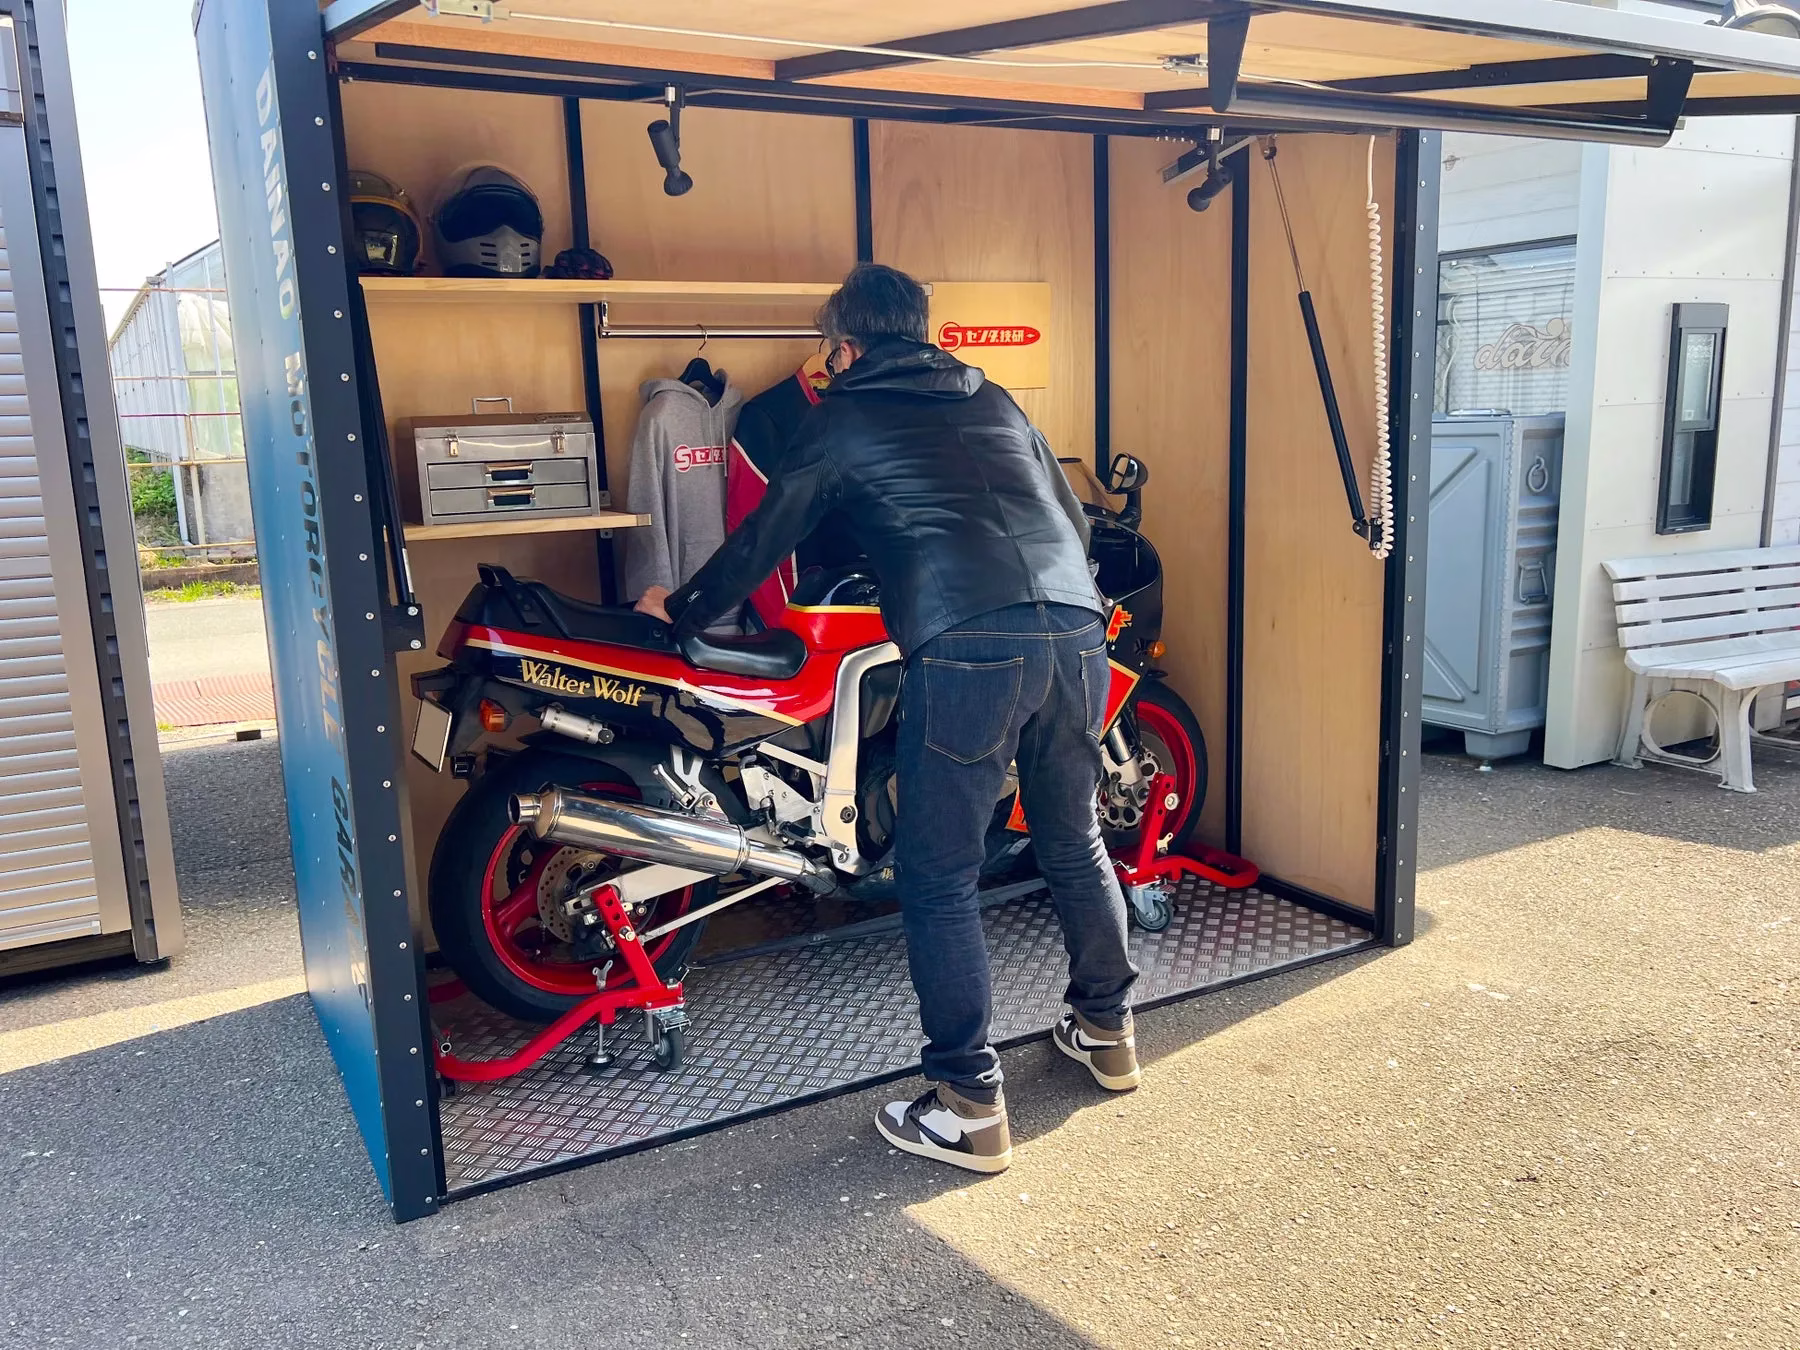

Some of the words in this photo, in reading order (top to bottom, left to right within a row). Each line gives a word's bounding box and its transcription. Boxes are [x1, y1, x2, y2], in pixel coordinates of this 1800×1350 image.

[256, 66, 295, 320] DAINAO
[520, 658, 591, 695] Walter
[592, 674, 646, 707] Wolf
